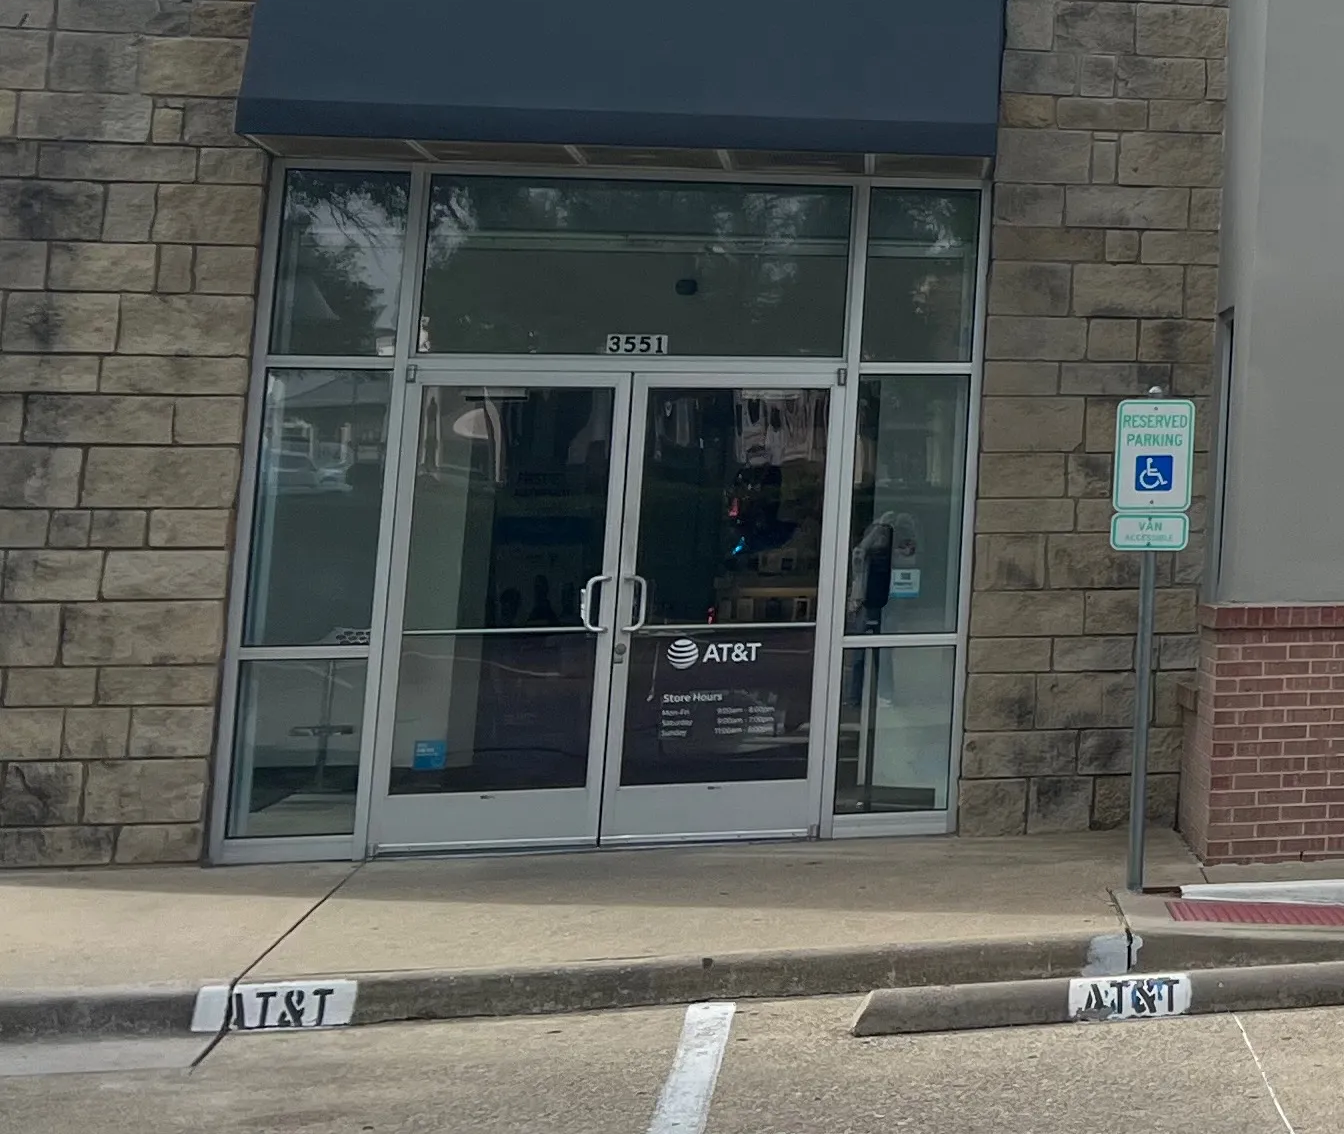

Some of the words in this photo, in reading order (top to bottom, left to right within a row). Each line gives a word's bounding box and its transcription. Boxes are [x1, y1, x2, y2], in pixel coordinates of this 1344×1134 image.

[608, 335, 663, 354] 3551
[1123, 414, 1188, 428] RESERVED
[1126, 433, 1183, 447] PARKING
[1138, 521, 1163, 532] VAN
[702, 642, 762, 663] AT&T
[662, 693, 691, 704] Store
[692, 692, 723, 703] Hours
[1084, 978, 1180, 1014] AT&T
[231, 988, 334, 1029] AT&T
